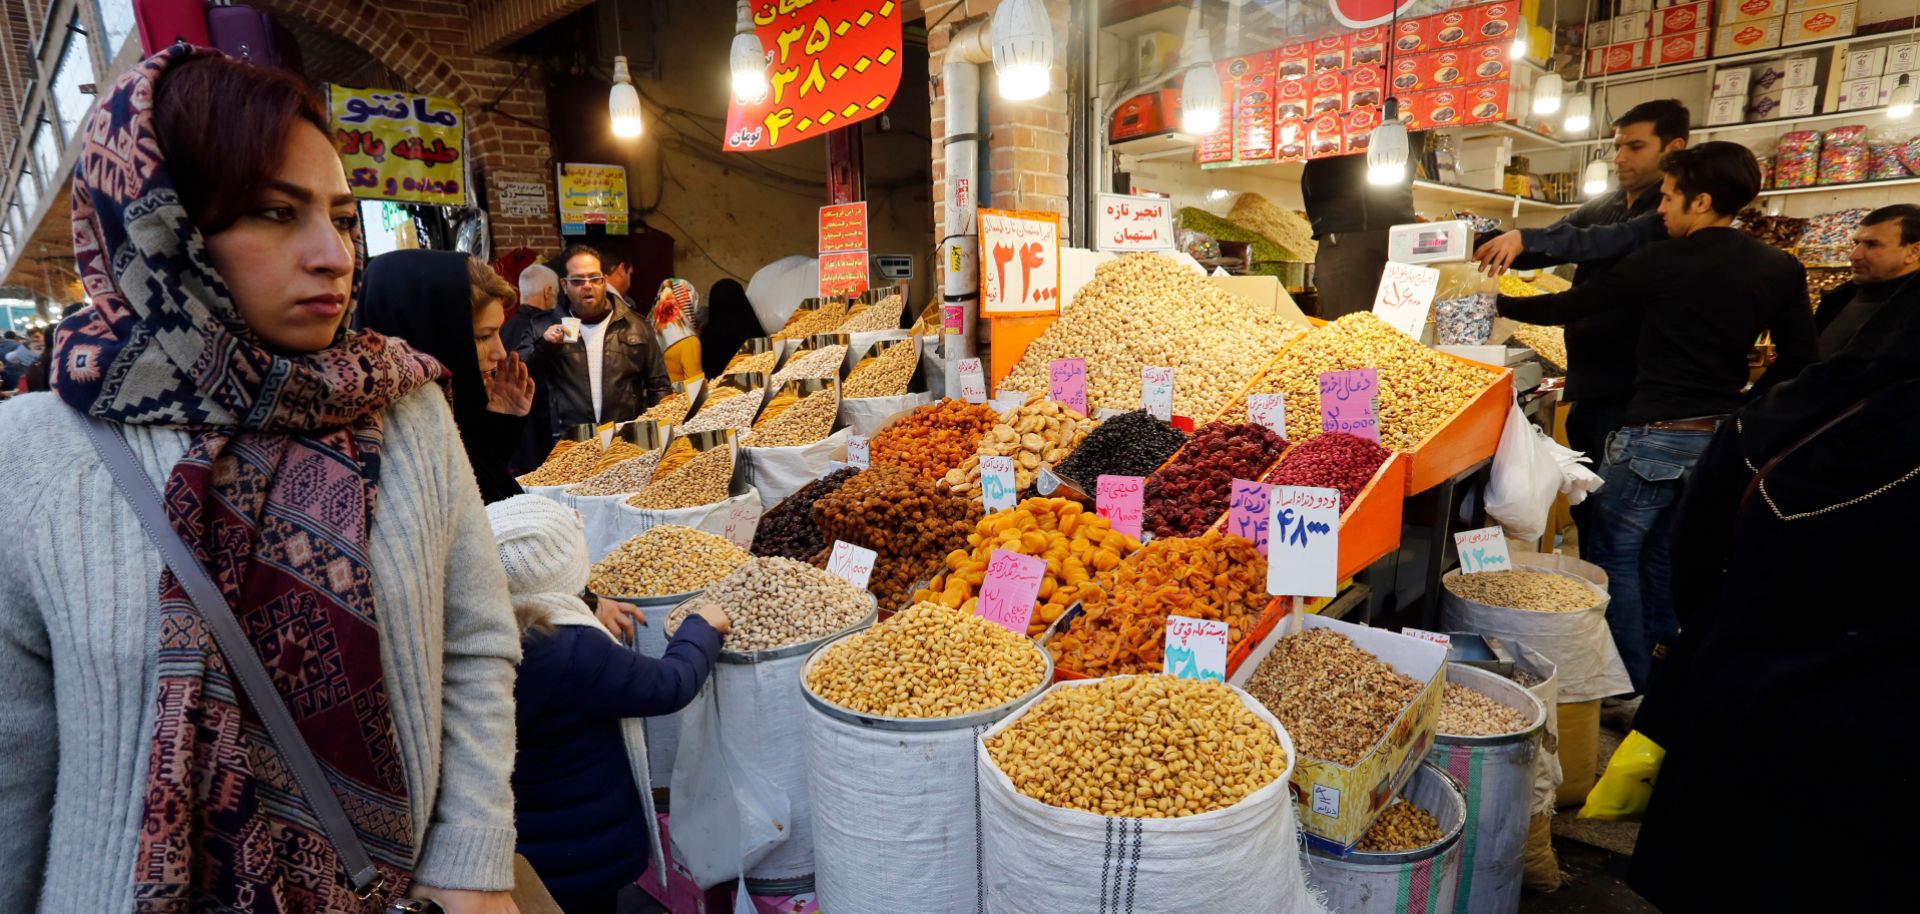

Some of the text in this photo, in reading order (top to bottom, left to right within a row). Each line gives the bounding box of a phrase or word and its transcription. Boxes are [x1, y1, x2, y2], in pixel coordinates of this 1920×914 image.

[770, 47, 897, 105] ۳۸۰۰۰
[339, 93, 458, 127] مانتو
[336, 128, 460, 168] طبقه بالا
[730, 129, 762, 147] تومان
[382, 177, 398, 196] و
[1106, 203, 1163, 222] انجیر تازه
[1113, 227, 1158, 244] استهبان
[992, 241, 1057, 305] ۳۴۰۰۰
[982, 474, 1016, 499] ۳۵۰۰۰
[1277, 508, 1330, 549] ۴۸۰۰۰
